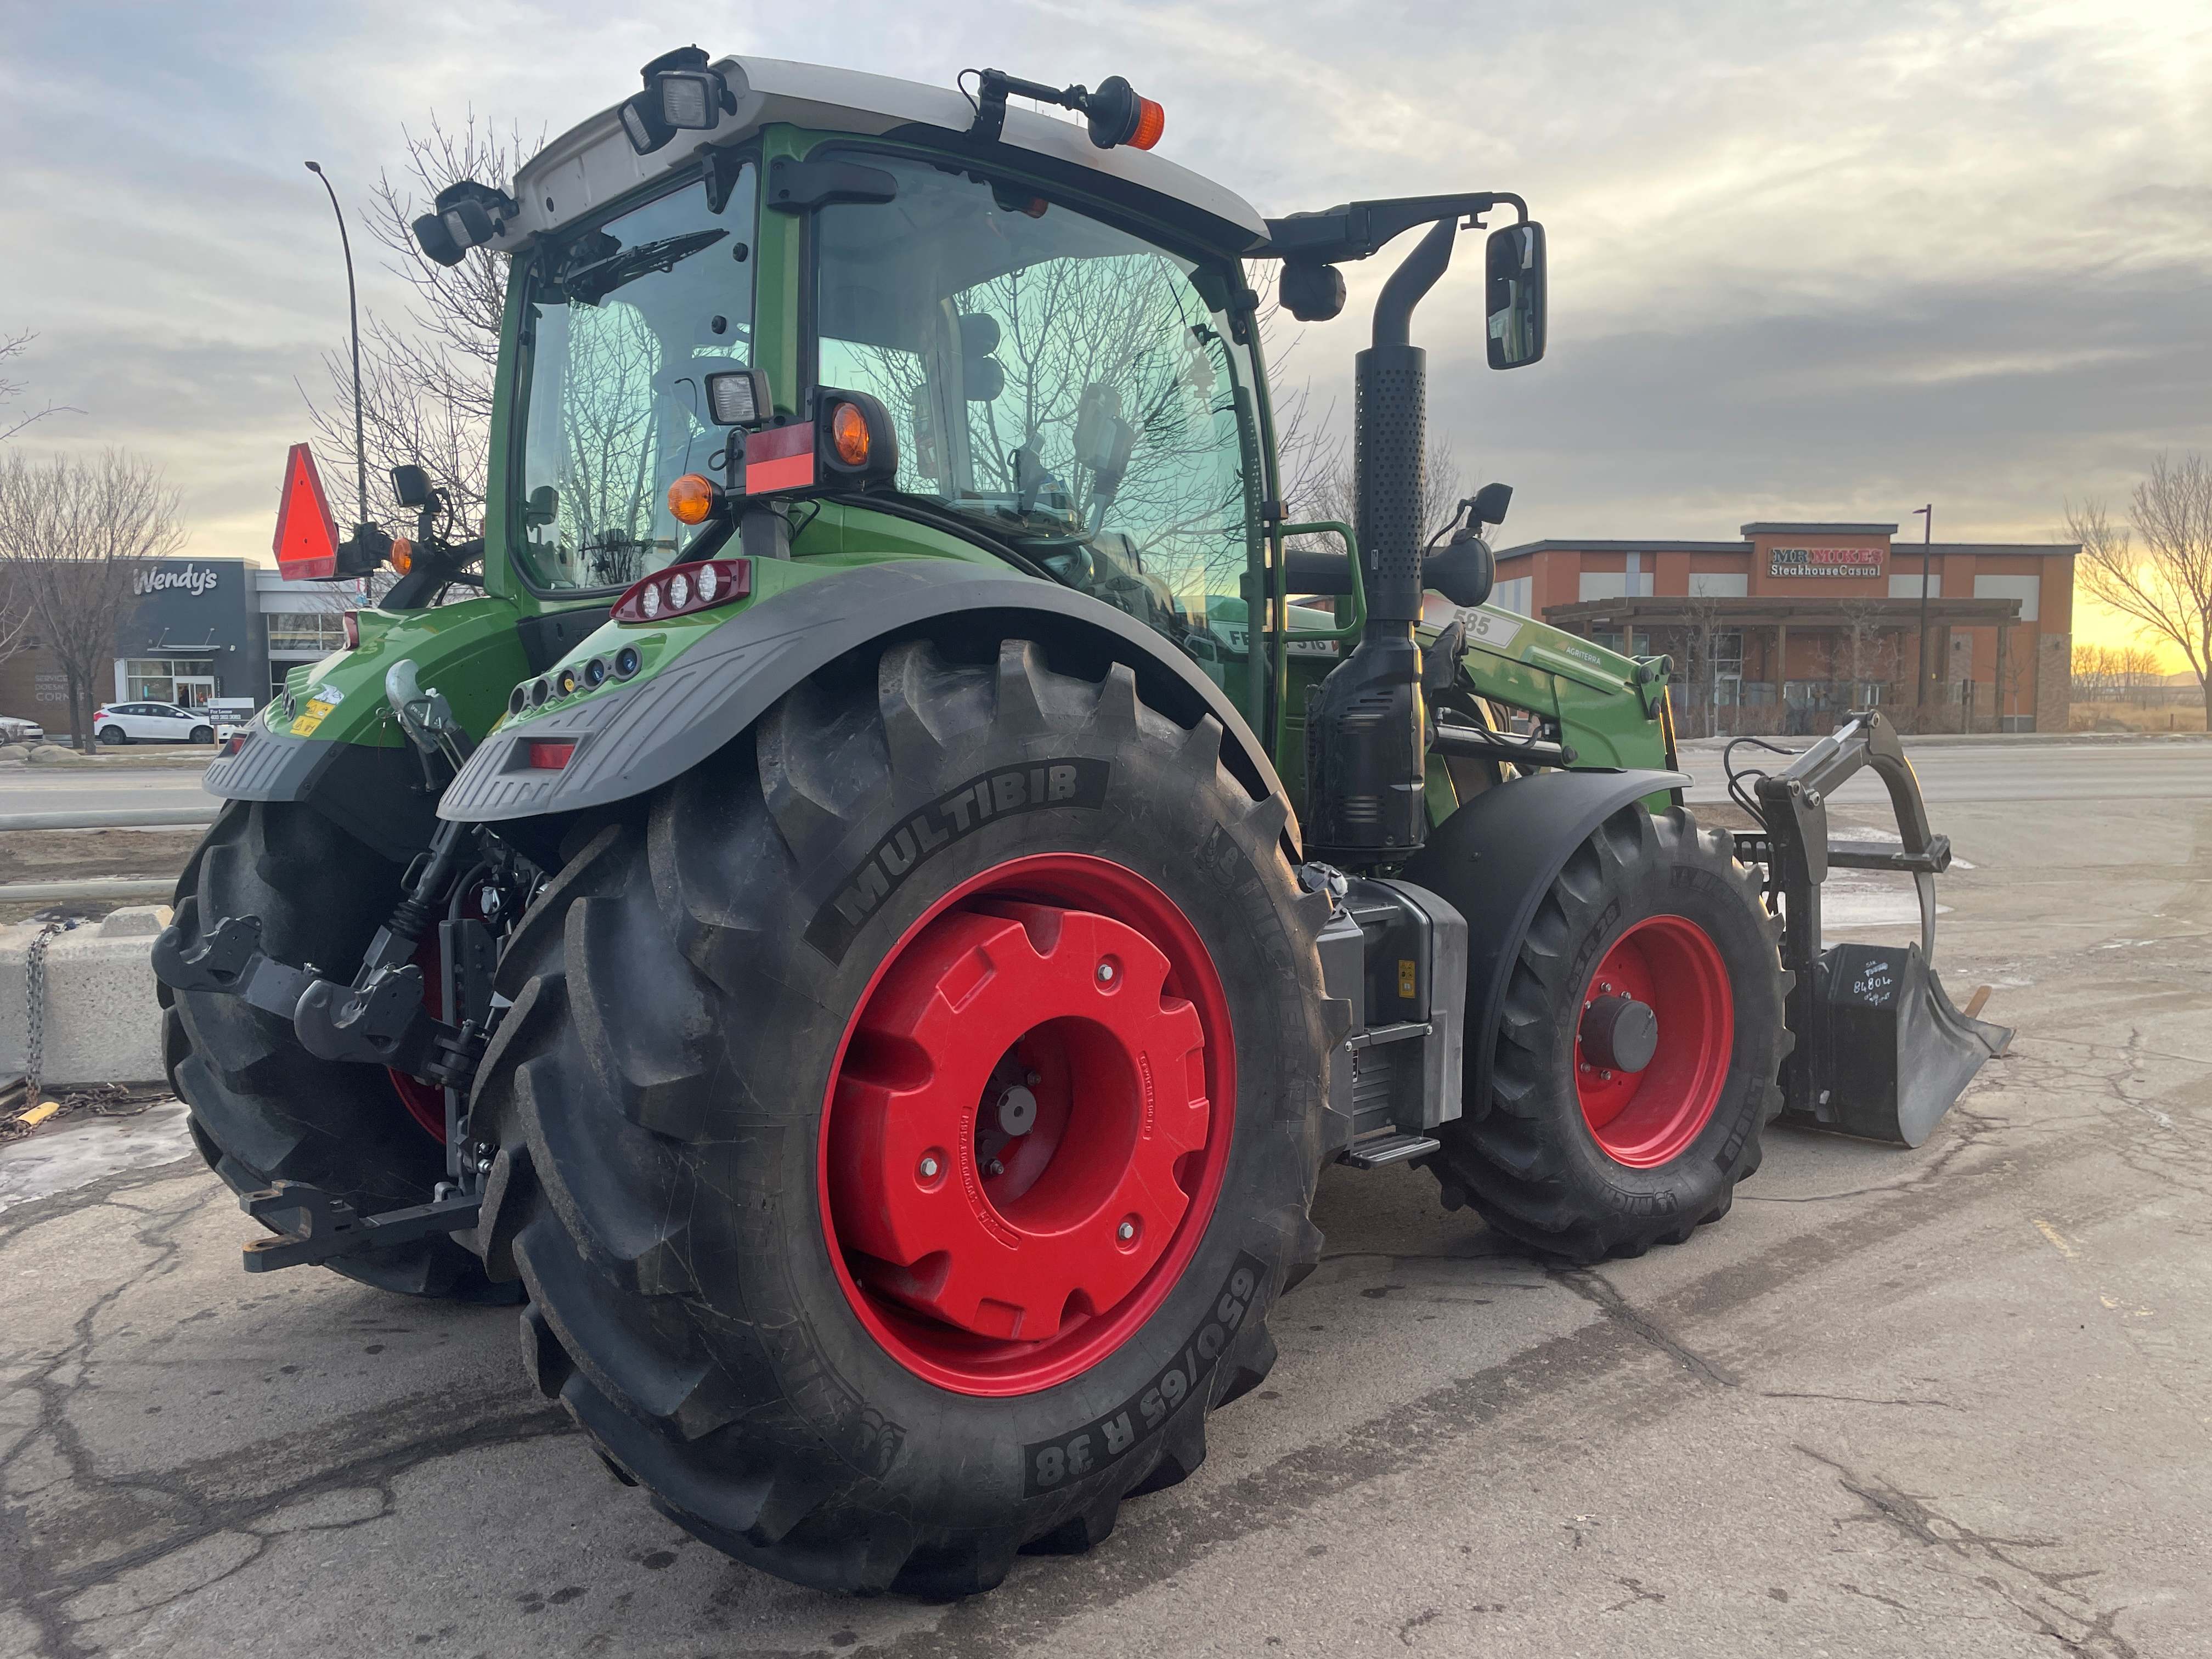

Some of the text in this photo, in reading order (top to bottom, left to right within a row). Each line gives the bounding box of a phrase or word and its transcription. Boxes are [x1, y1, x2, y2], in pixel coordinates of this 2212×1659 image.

[1773, 549, 1883, 565] MR MIKES
[133, 563, 217, 596] Wendy's
[1771, 564, 1880, 576] SteakhouseCasual
[1453, 609, 1491, 635] 585
[1566, 646, 1601, 665] AGRITERRA
[836, 764, 1077, 927] MULTIBIB
[1853, 976, 1893, 994] 84804
[1035, 1266, 1255, 1487] 650/65 R 38
